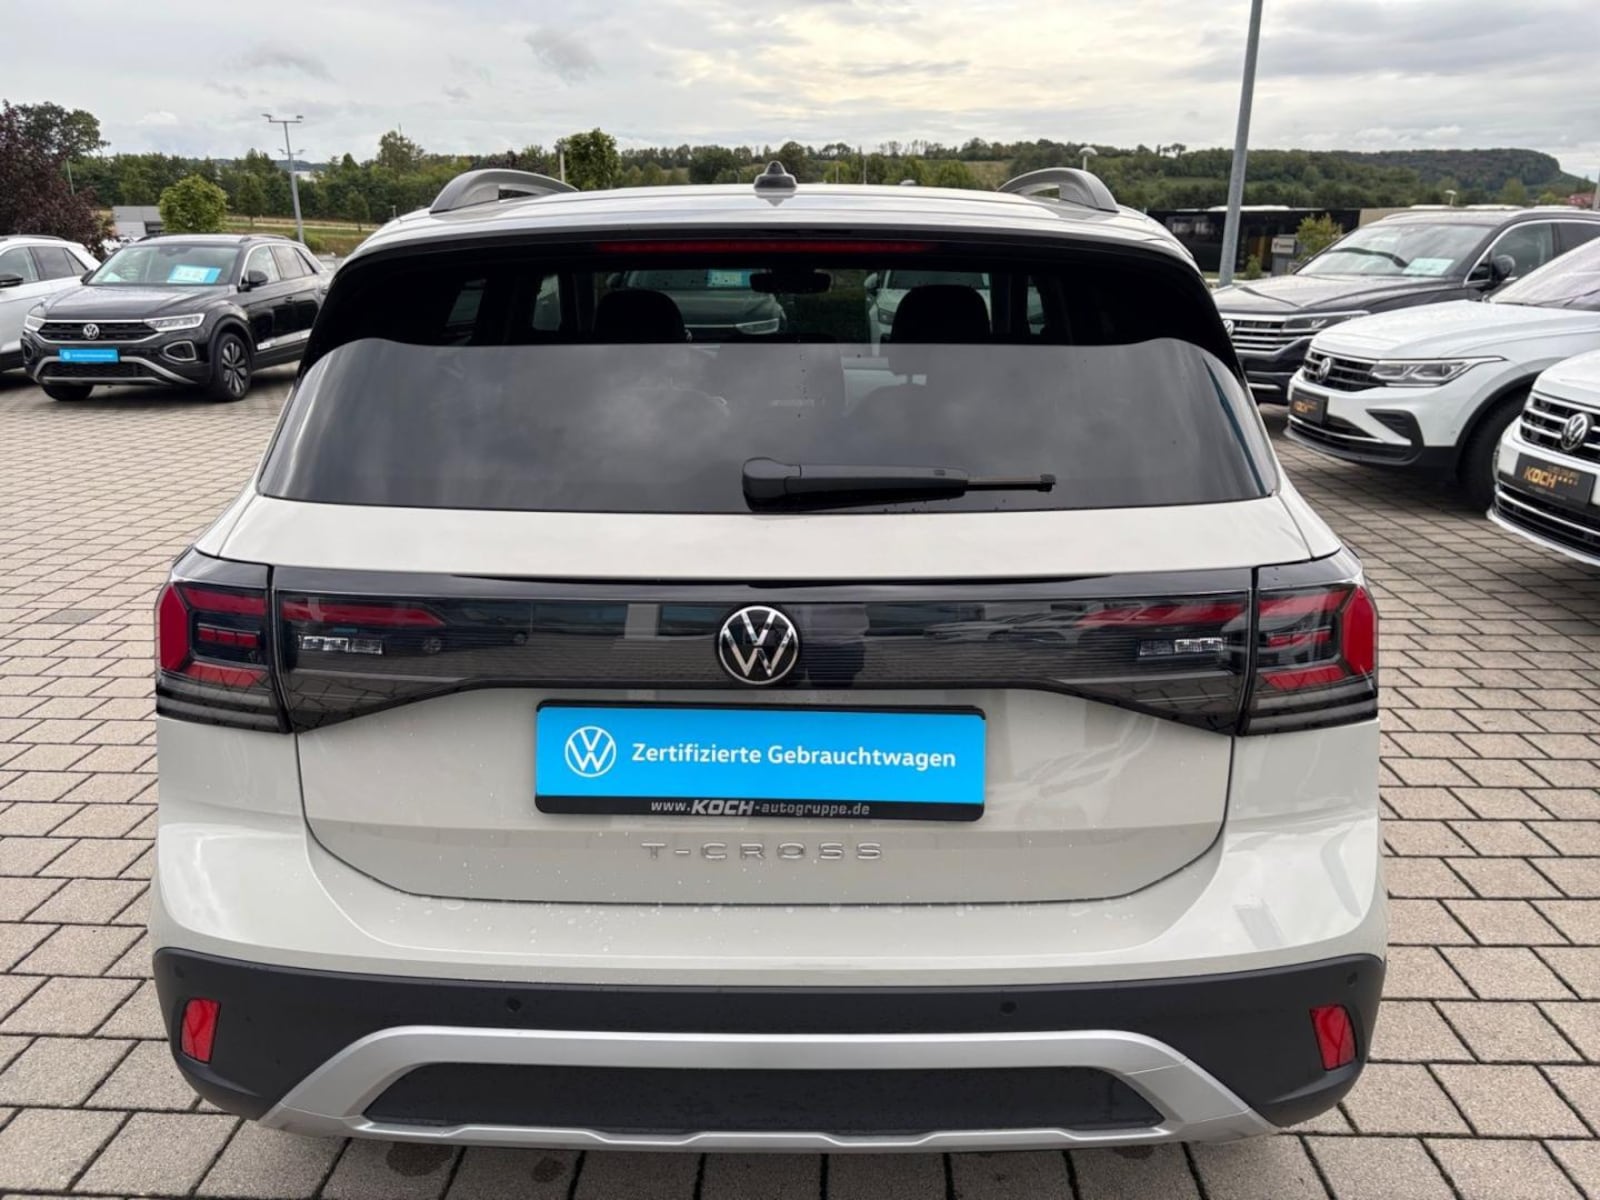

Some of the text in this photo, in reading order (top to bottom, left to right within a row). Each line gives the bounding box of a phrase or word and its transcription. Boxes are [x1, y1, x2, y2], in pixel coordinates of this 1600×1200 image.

[1523, 466, 1557, 489] KOCH
[718, 605, 799, 685] VW
[564, 726, 617, 778] VW
[632, 743, 957, 772] Zertifizierte Gebrauchtwagen
[650, 799, 870, 818] www.KOCH-autogruppe.de
[641, 842, 883, 861] T-CROSS
